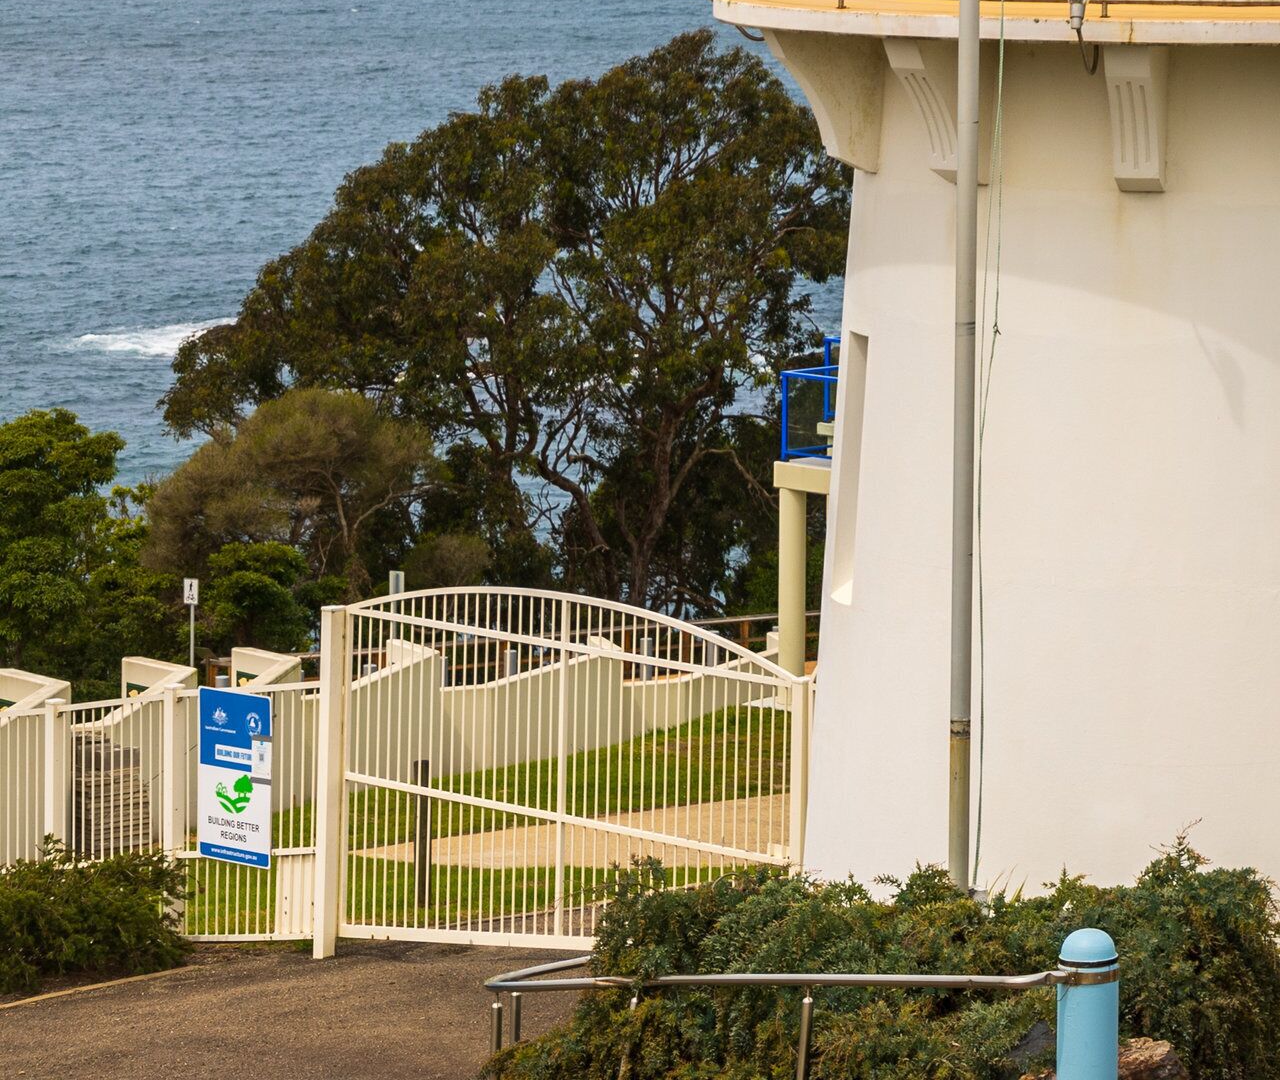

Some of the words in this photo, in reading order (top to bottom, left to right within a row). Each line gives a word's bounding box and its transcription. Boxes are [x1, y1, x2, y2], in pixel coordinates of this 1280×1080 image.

[208, 815, 235, 828] BUILDING
[236, 821, 260, 832] BETTER
[220, 830, 247, 843] REGIONS
